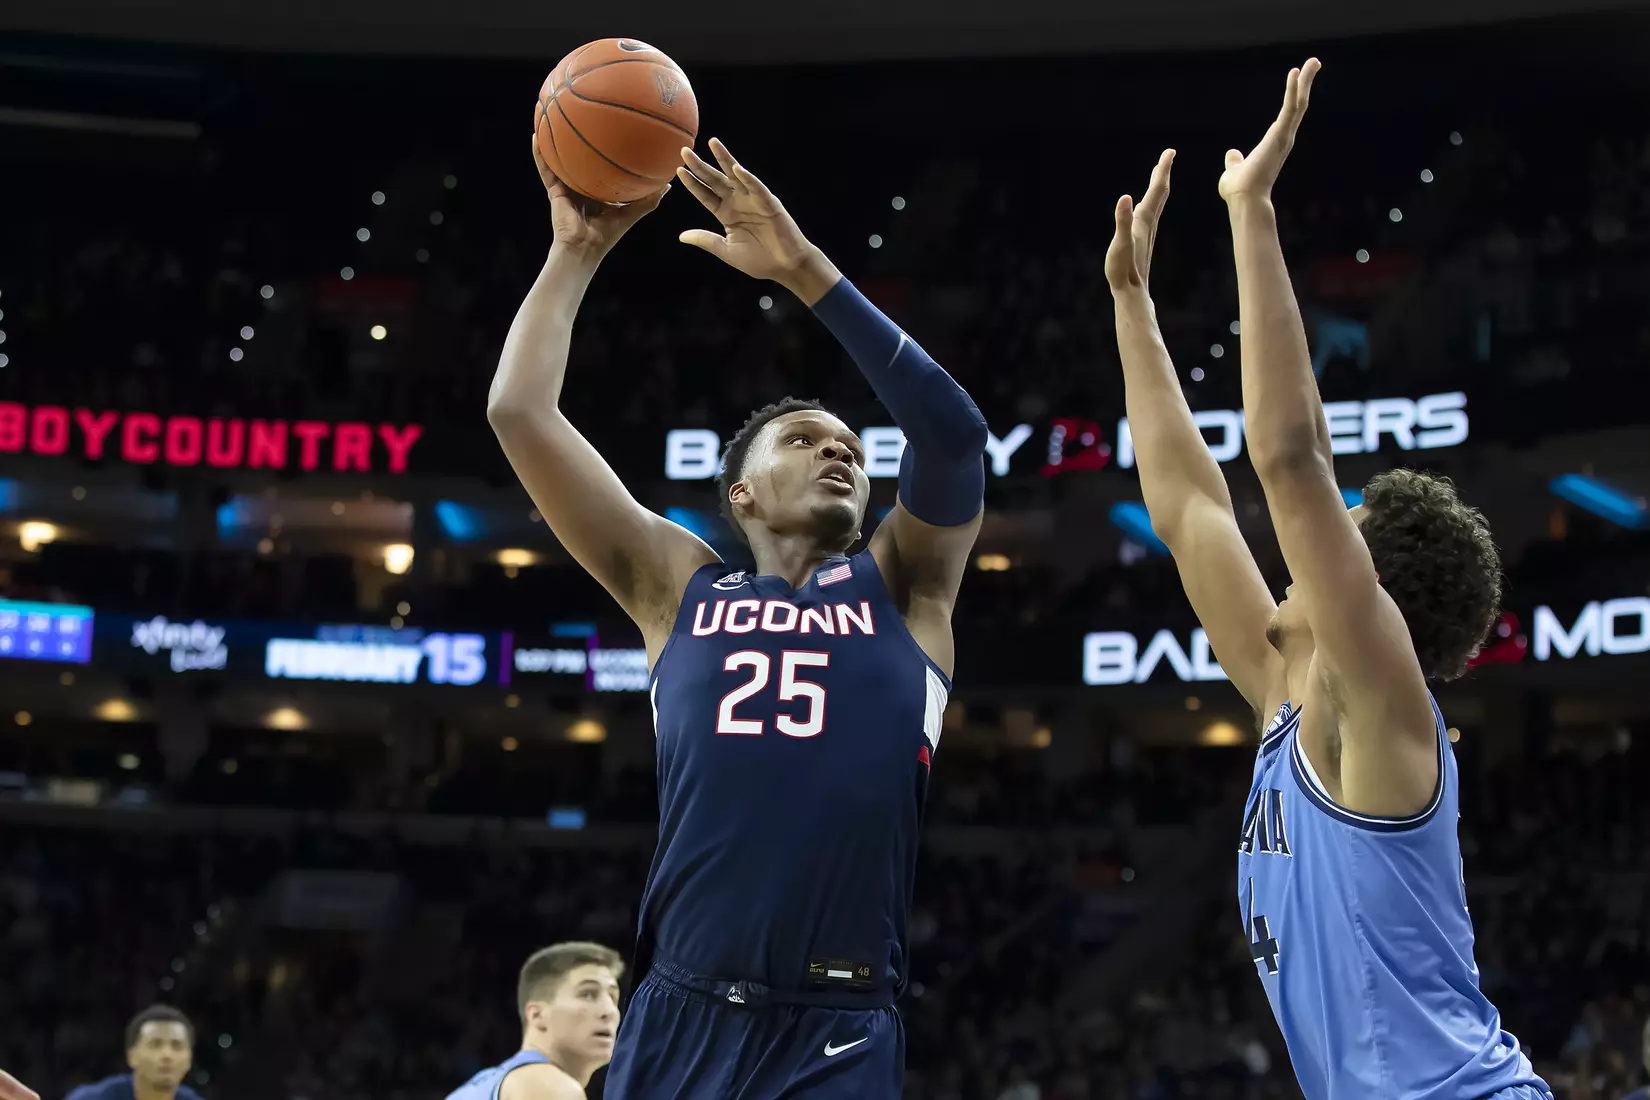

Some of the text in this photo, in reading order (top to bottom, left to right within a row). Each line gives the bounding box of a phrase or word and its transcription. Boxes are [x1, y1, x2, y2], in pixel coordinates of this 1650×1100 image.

[0, 402, 422, 473] BOYCOUNTRY
[1116, 391, 1469, 469] OERS
[692, 599, 876, 636] UCONN
[423, 633, 486, 686] 15
[715, 649, 830, 737] 25
[857, 966, 870, 976] 48
